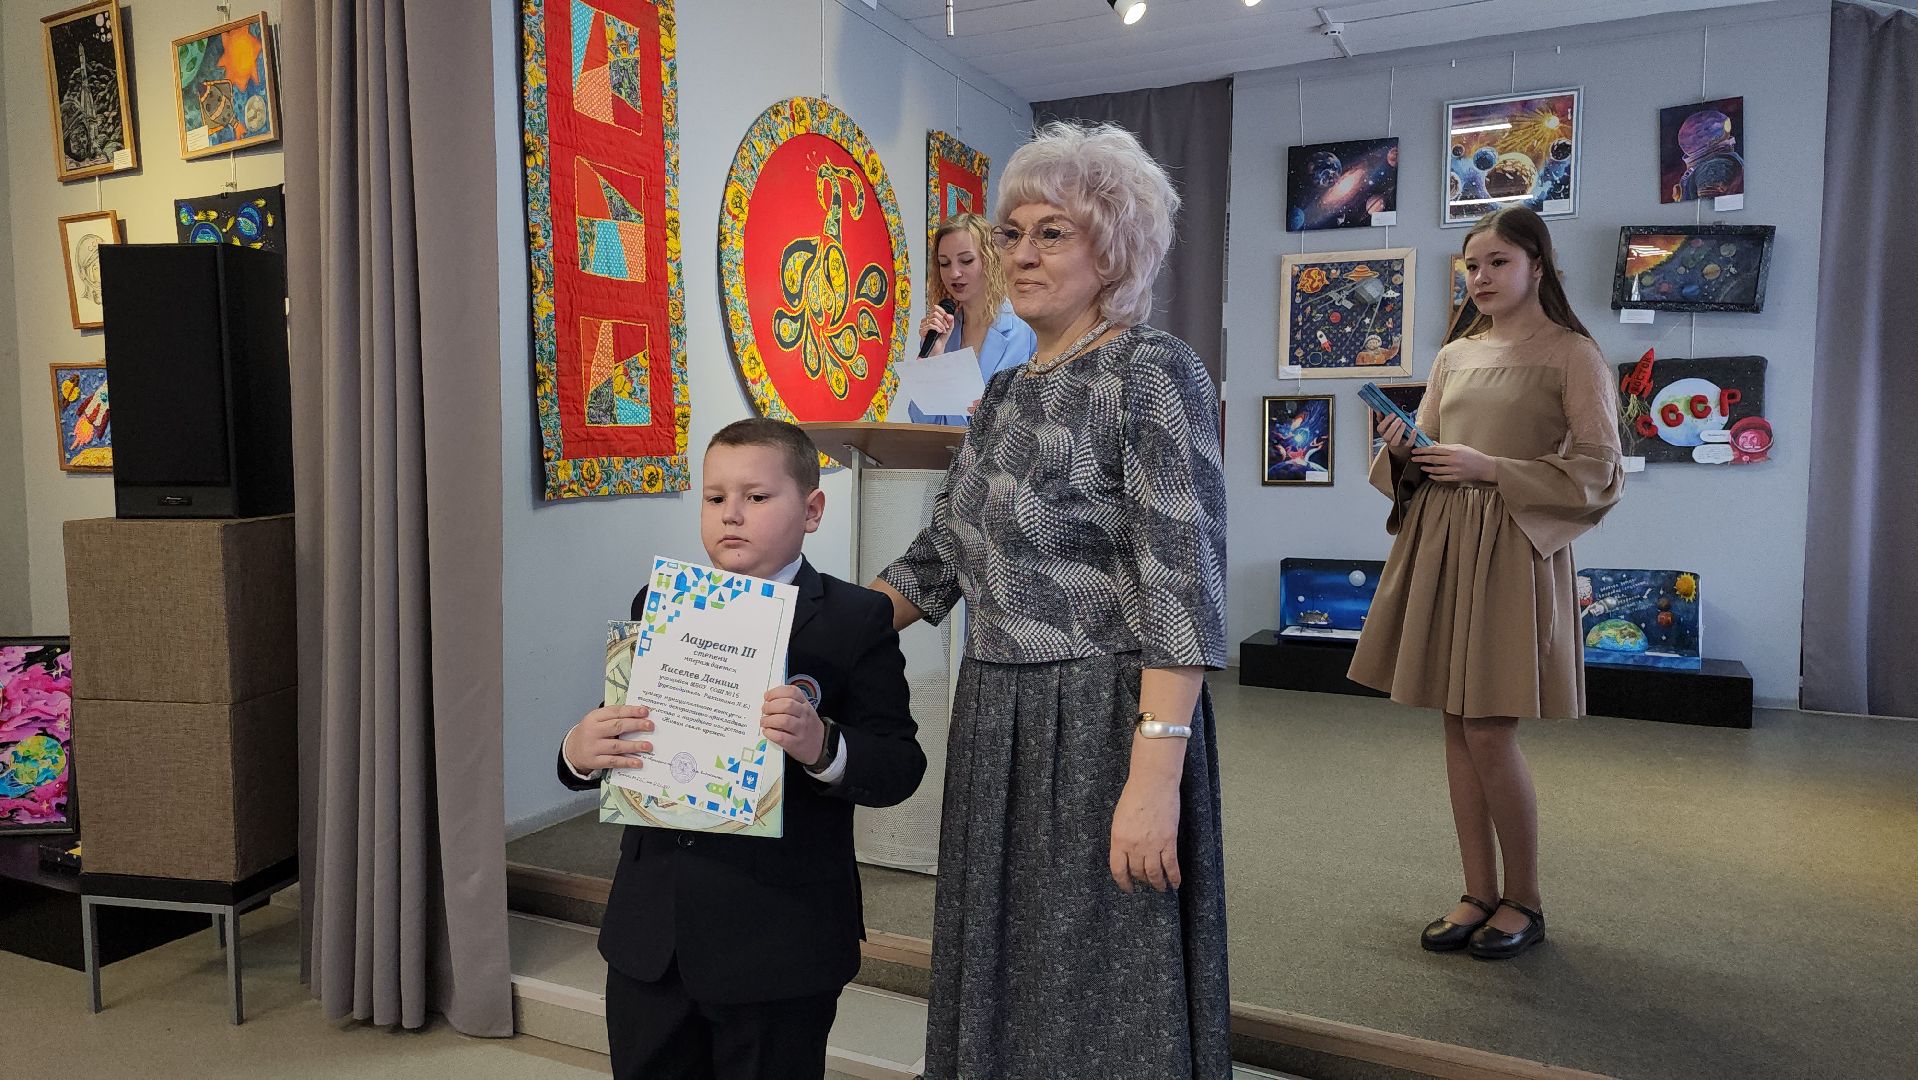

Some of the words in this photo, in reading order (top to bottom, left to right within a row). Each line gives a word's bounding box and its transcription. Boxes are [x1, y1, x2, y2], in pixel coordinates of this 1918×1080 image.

[1636, 388, 1742, 438] СССР
[680, 632, 739, 655] Лауреат
[741, 645, 758, 659] III
[693, 650, 728, 663] степени
[660, 663, 700, 680] Киселев
[701, 673, 739, 690] Даниил
[684, 656, 737, 673] награждается
